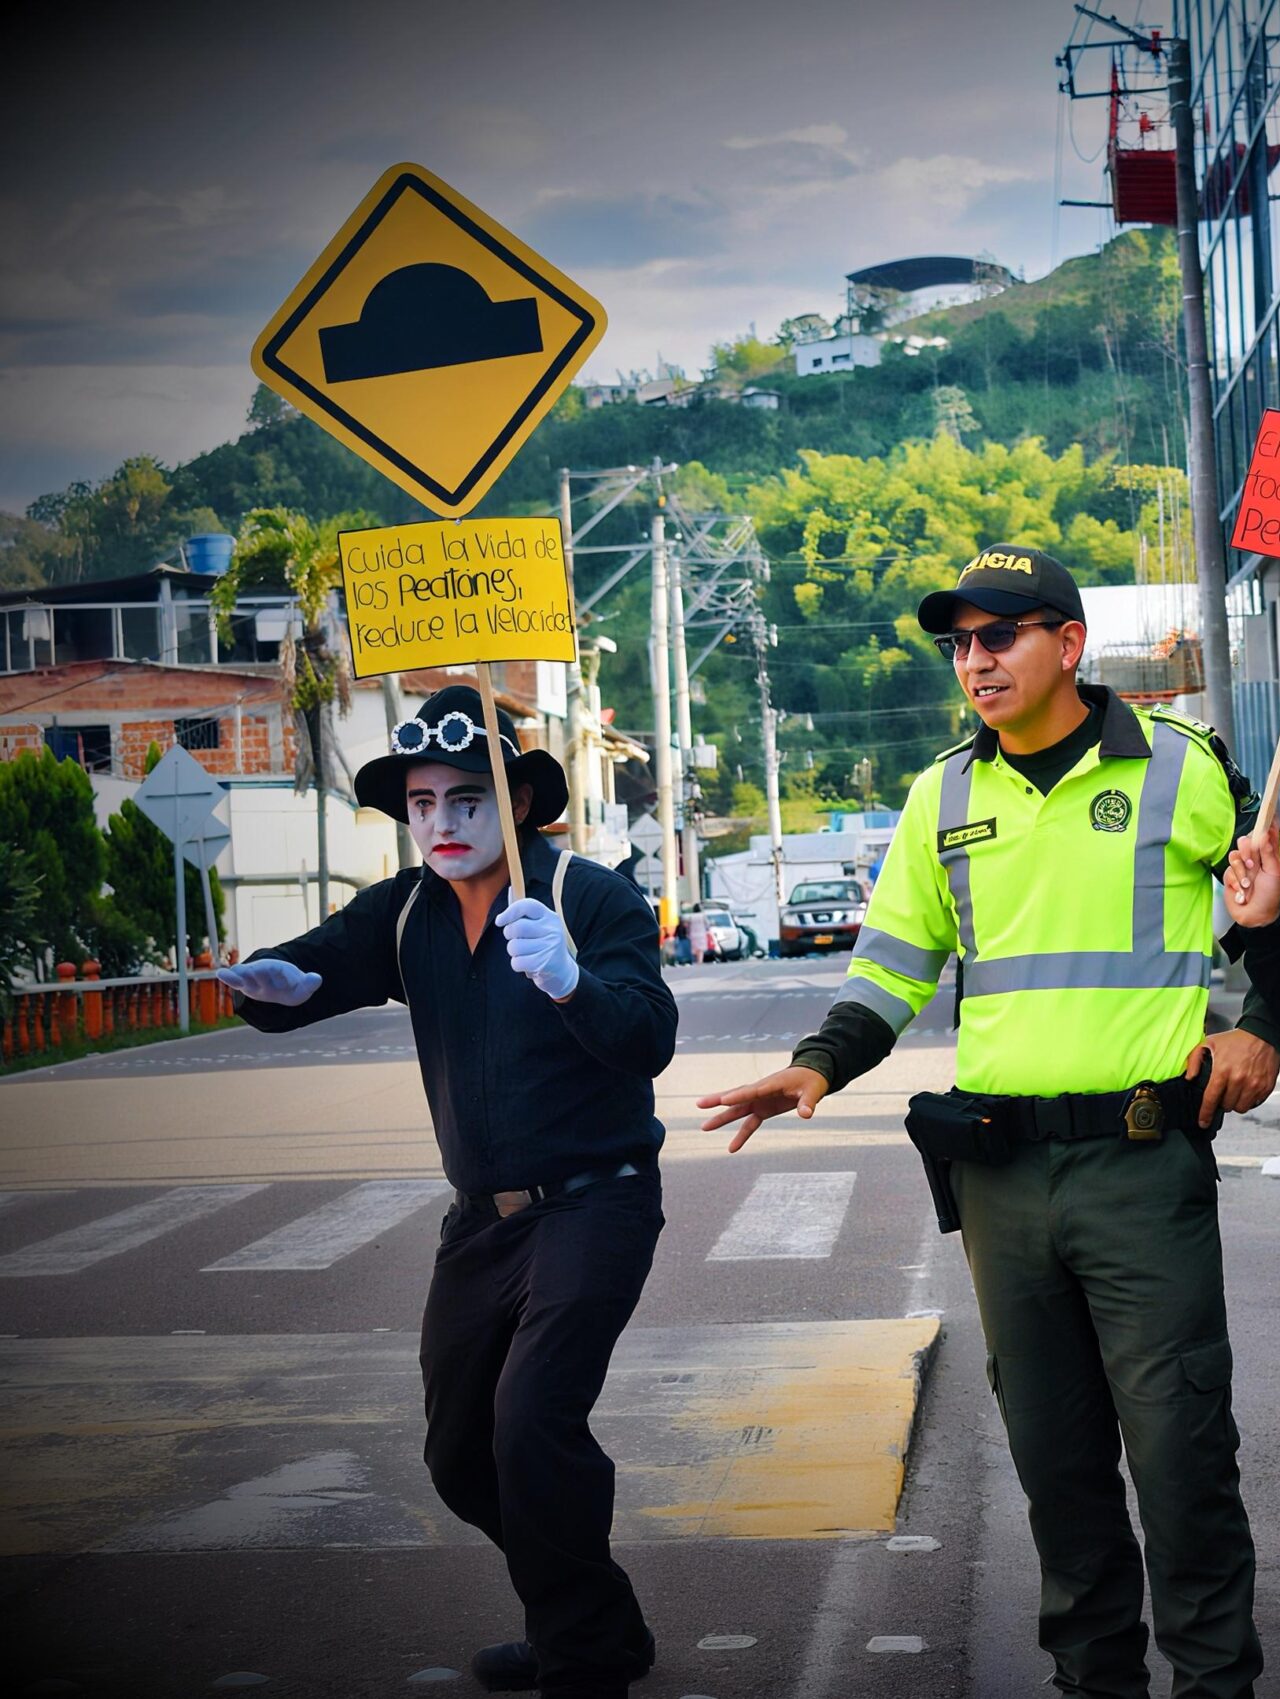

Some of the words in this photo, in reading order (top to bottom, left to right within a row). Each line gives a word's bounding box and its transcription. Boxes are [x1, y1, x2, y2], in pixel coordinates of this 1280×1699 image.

[347, 538, 425, 574] Cuida
[441, 531, 469, 561] la
[535, 529, 558, 561] de
[353, 581, 388, 610] los
[355, 614, 444, 654] reduce
[454, 607, 479, 638] la
